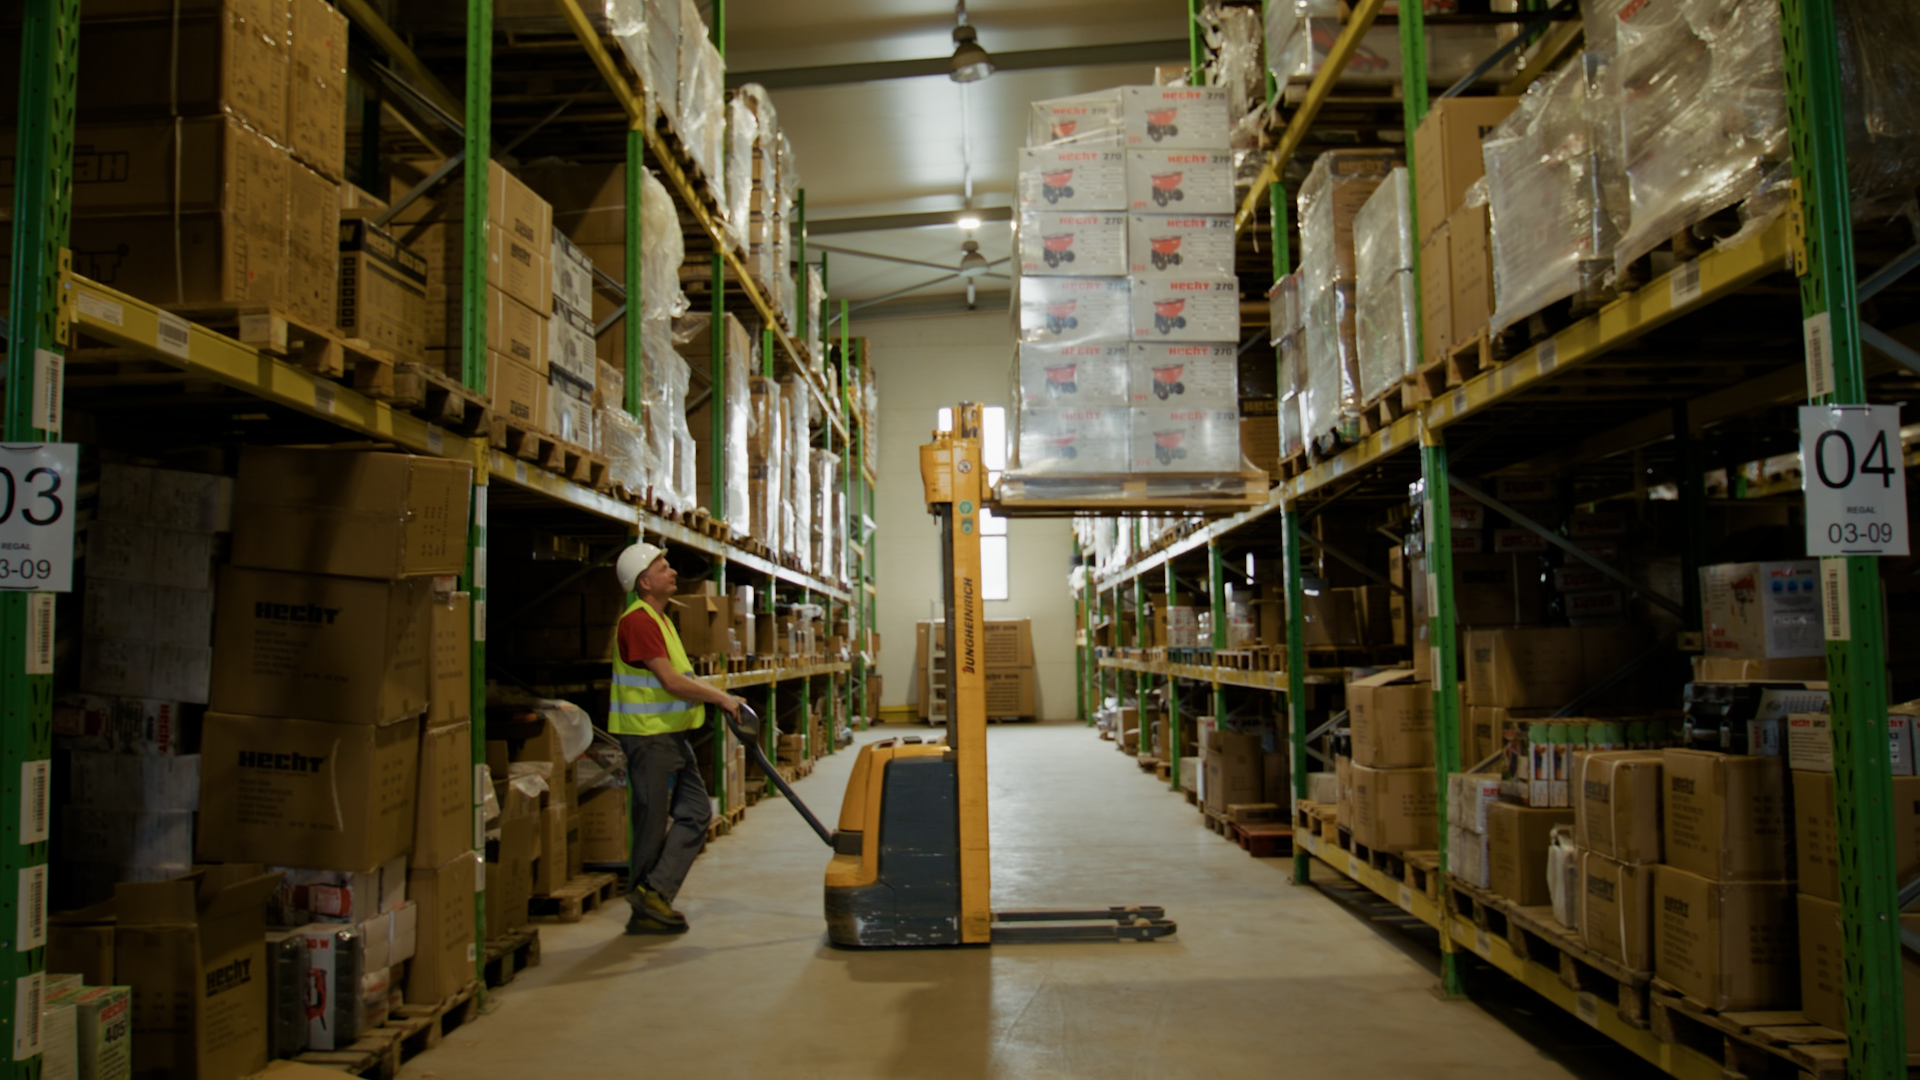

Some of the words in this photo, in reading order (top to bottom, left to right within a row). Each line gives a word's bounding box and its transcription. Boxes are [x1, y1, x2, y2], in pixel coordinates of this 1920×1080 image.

[1214, 348, 1232, 356] 270
[1815, 429, 1895, 490] 04
[1828, 523, 1892, 544] 03-09
[962, 577, 975, 674] JUNGHEINRICH
[105, 1019, 126, 1043] 405
